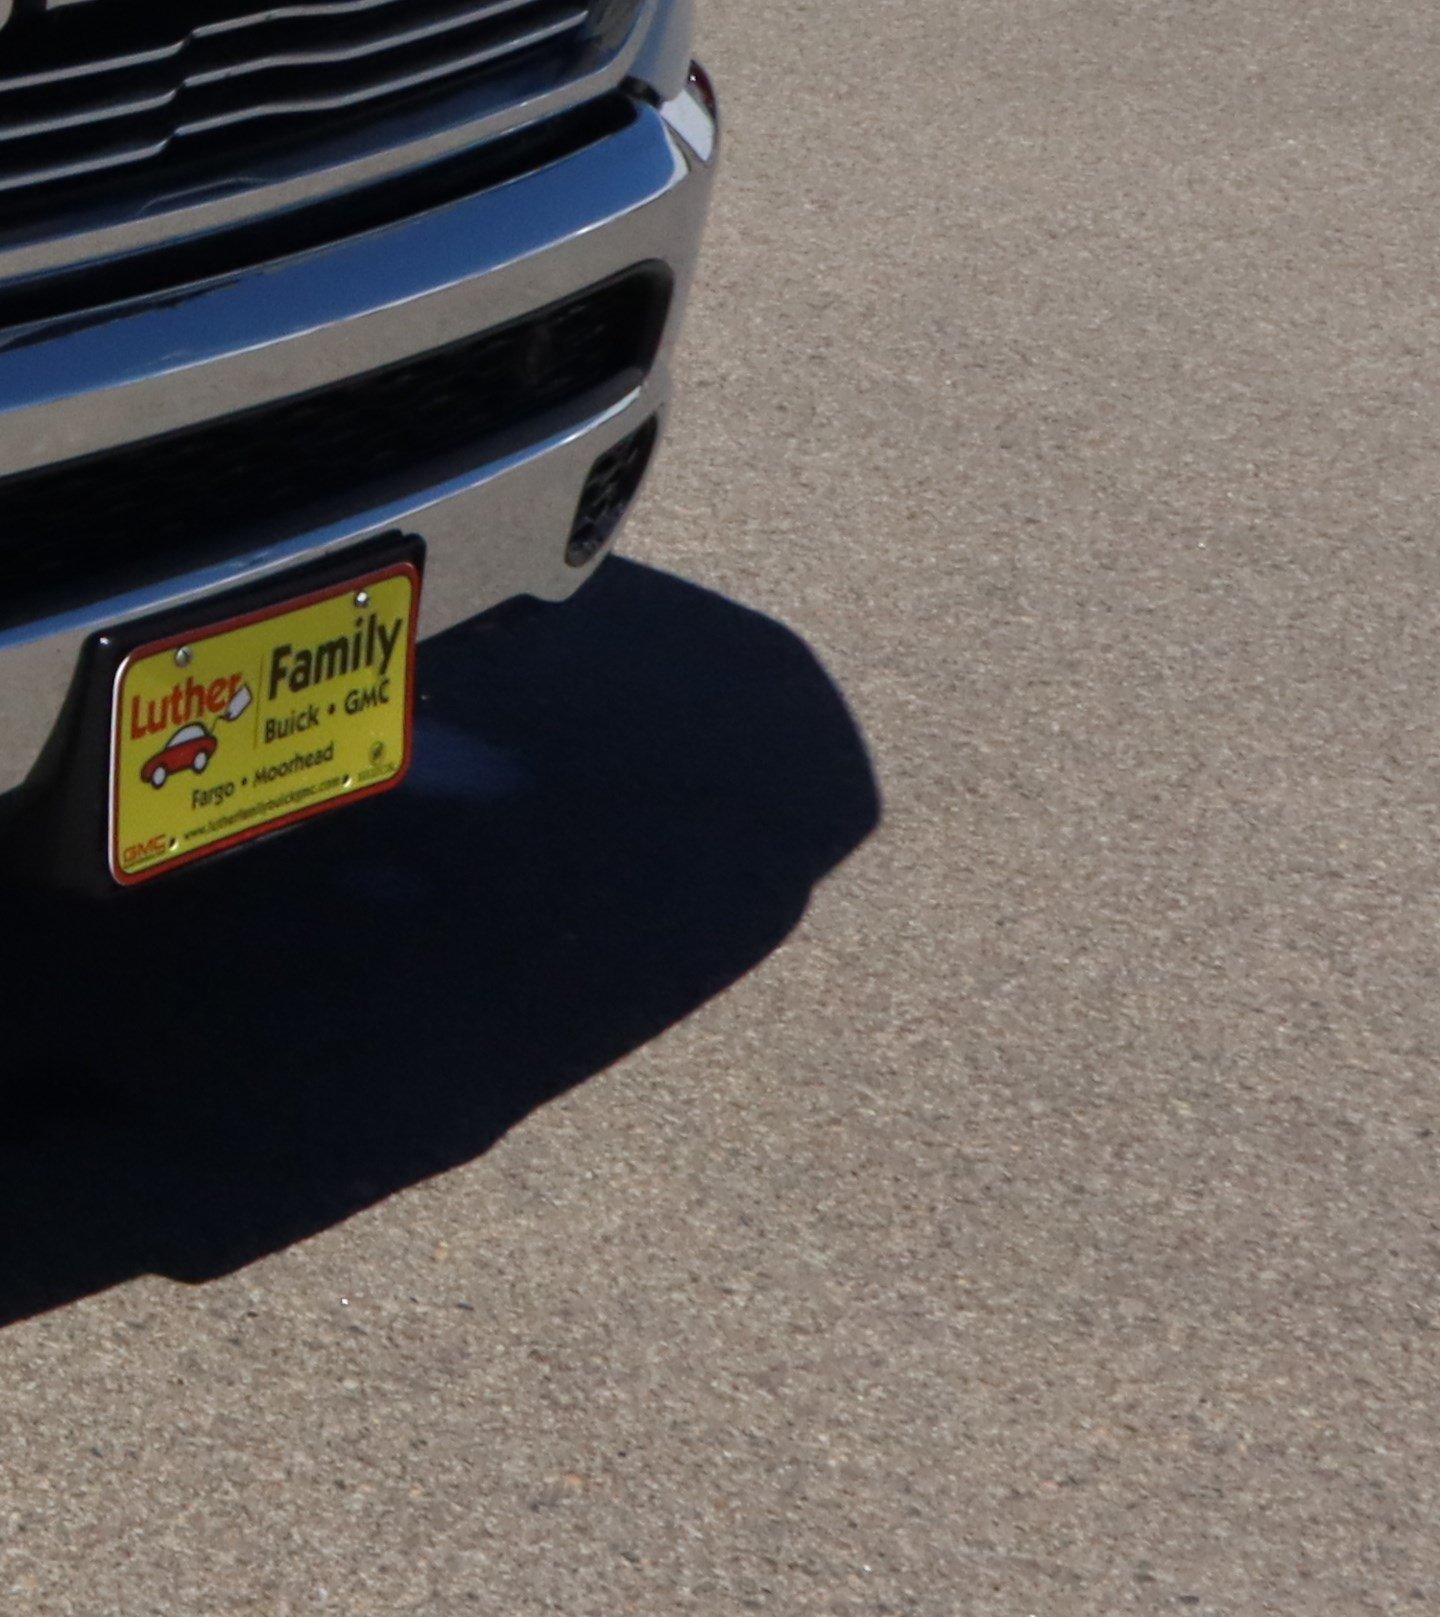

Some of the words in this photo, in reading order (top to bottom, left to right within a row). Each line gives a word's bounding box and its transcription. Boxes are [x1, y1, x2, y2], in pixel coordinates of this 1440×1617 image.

[268, 614, 403, 701] Family
[131, 671, 243, 741] Luther
[264, 703, 320, 745] Buick
[344, 676, 391, 716] GMC
[190, 781, 236, 811] Fargo
[252, 740, 335, 789] Moorhead
[123, 833, 168, 864] GMC
